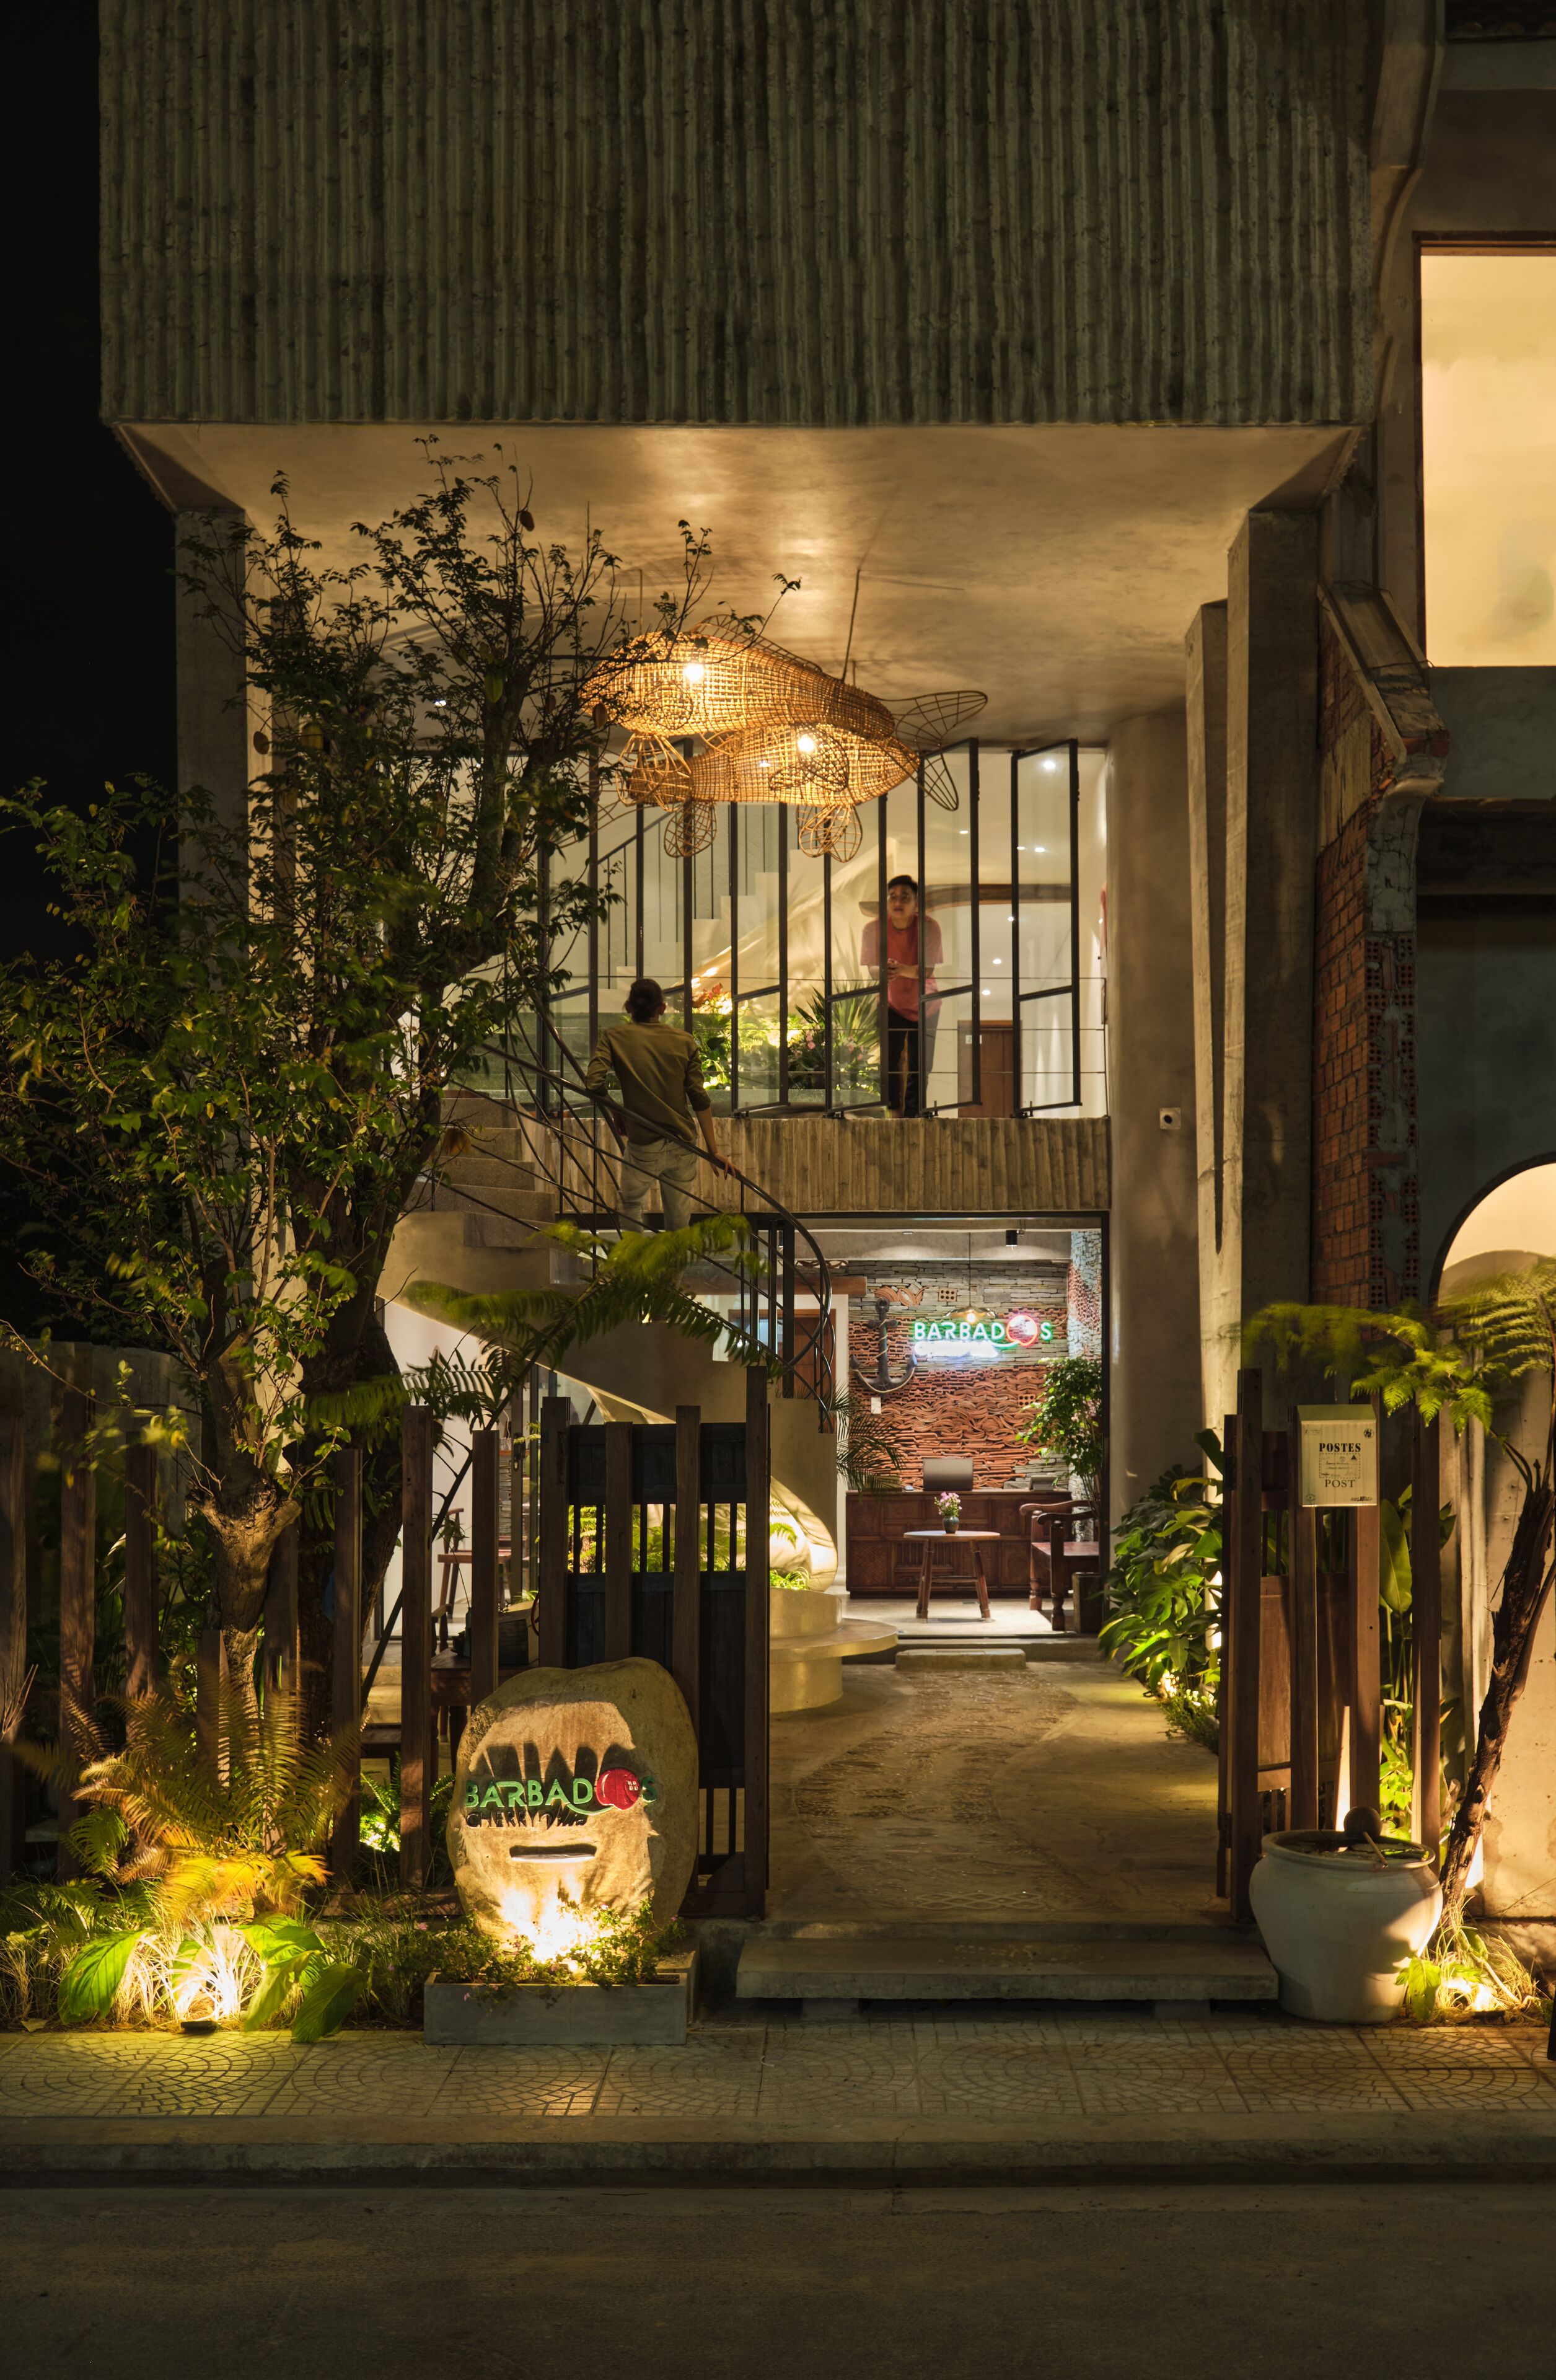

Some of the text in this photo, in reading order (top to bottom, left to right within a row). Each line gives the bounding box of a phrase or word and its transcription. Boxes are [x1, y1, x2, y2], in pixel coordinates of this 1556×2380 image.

[1319, 1442, 1361, 1452] POSTES
[1325, 1479, 1356, 1488] POST
[467, 1810, 534, 1828] CHERRY
